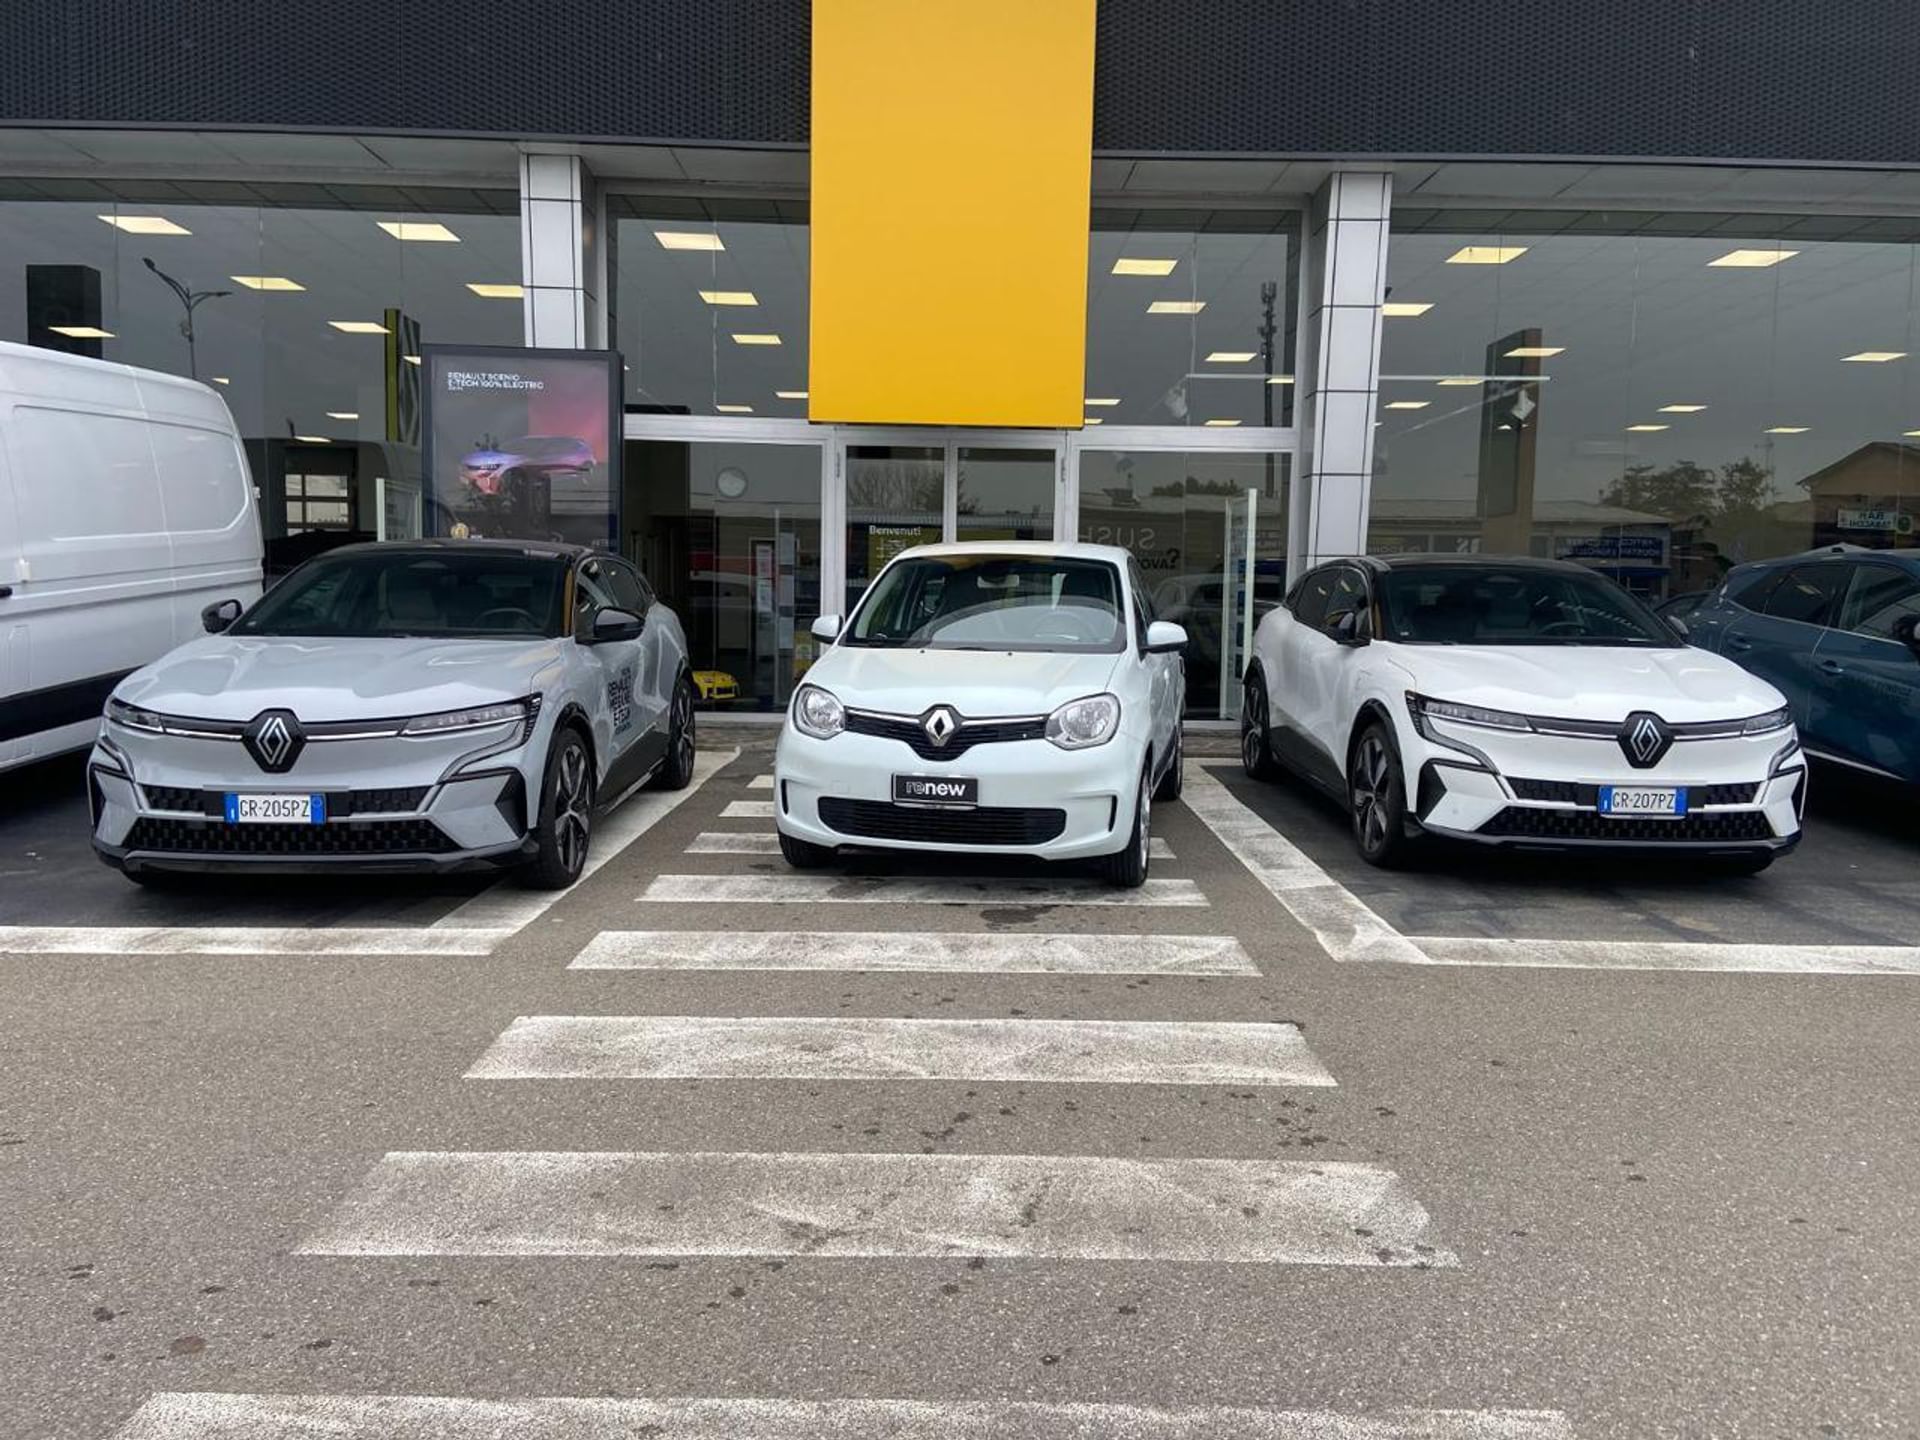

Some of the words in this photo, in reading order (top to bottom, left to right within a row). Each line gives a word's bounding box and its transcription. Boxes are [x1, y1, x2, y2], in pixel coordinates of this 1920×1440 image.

[448, 371, 486, 381] RENAULT
[868, 525, 922, 536] Benvenuti
[905, 781, 967, 797] renew
